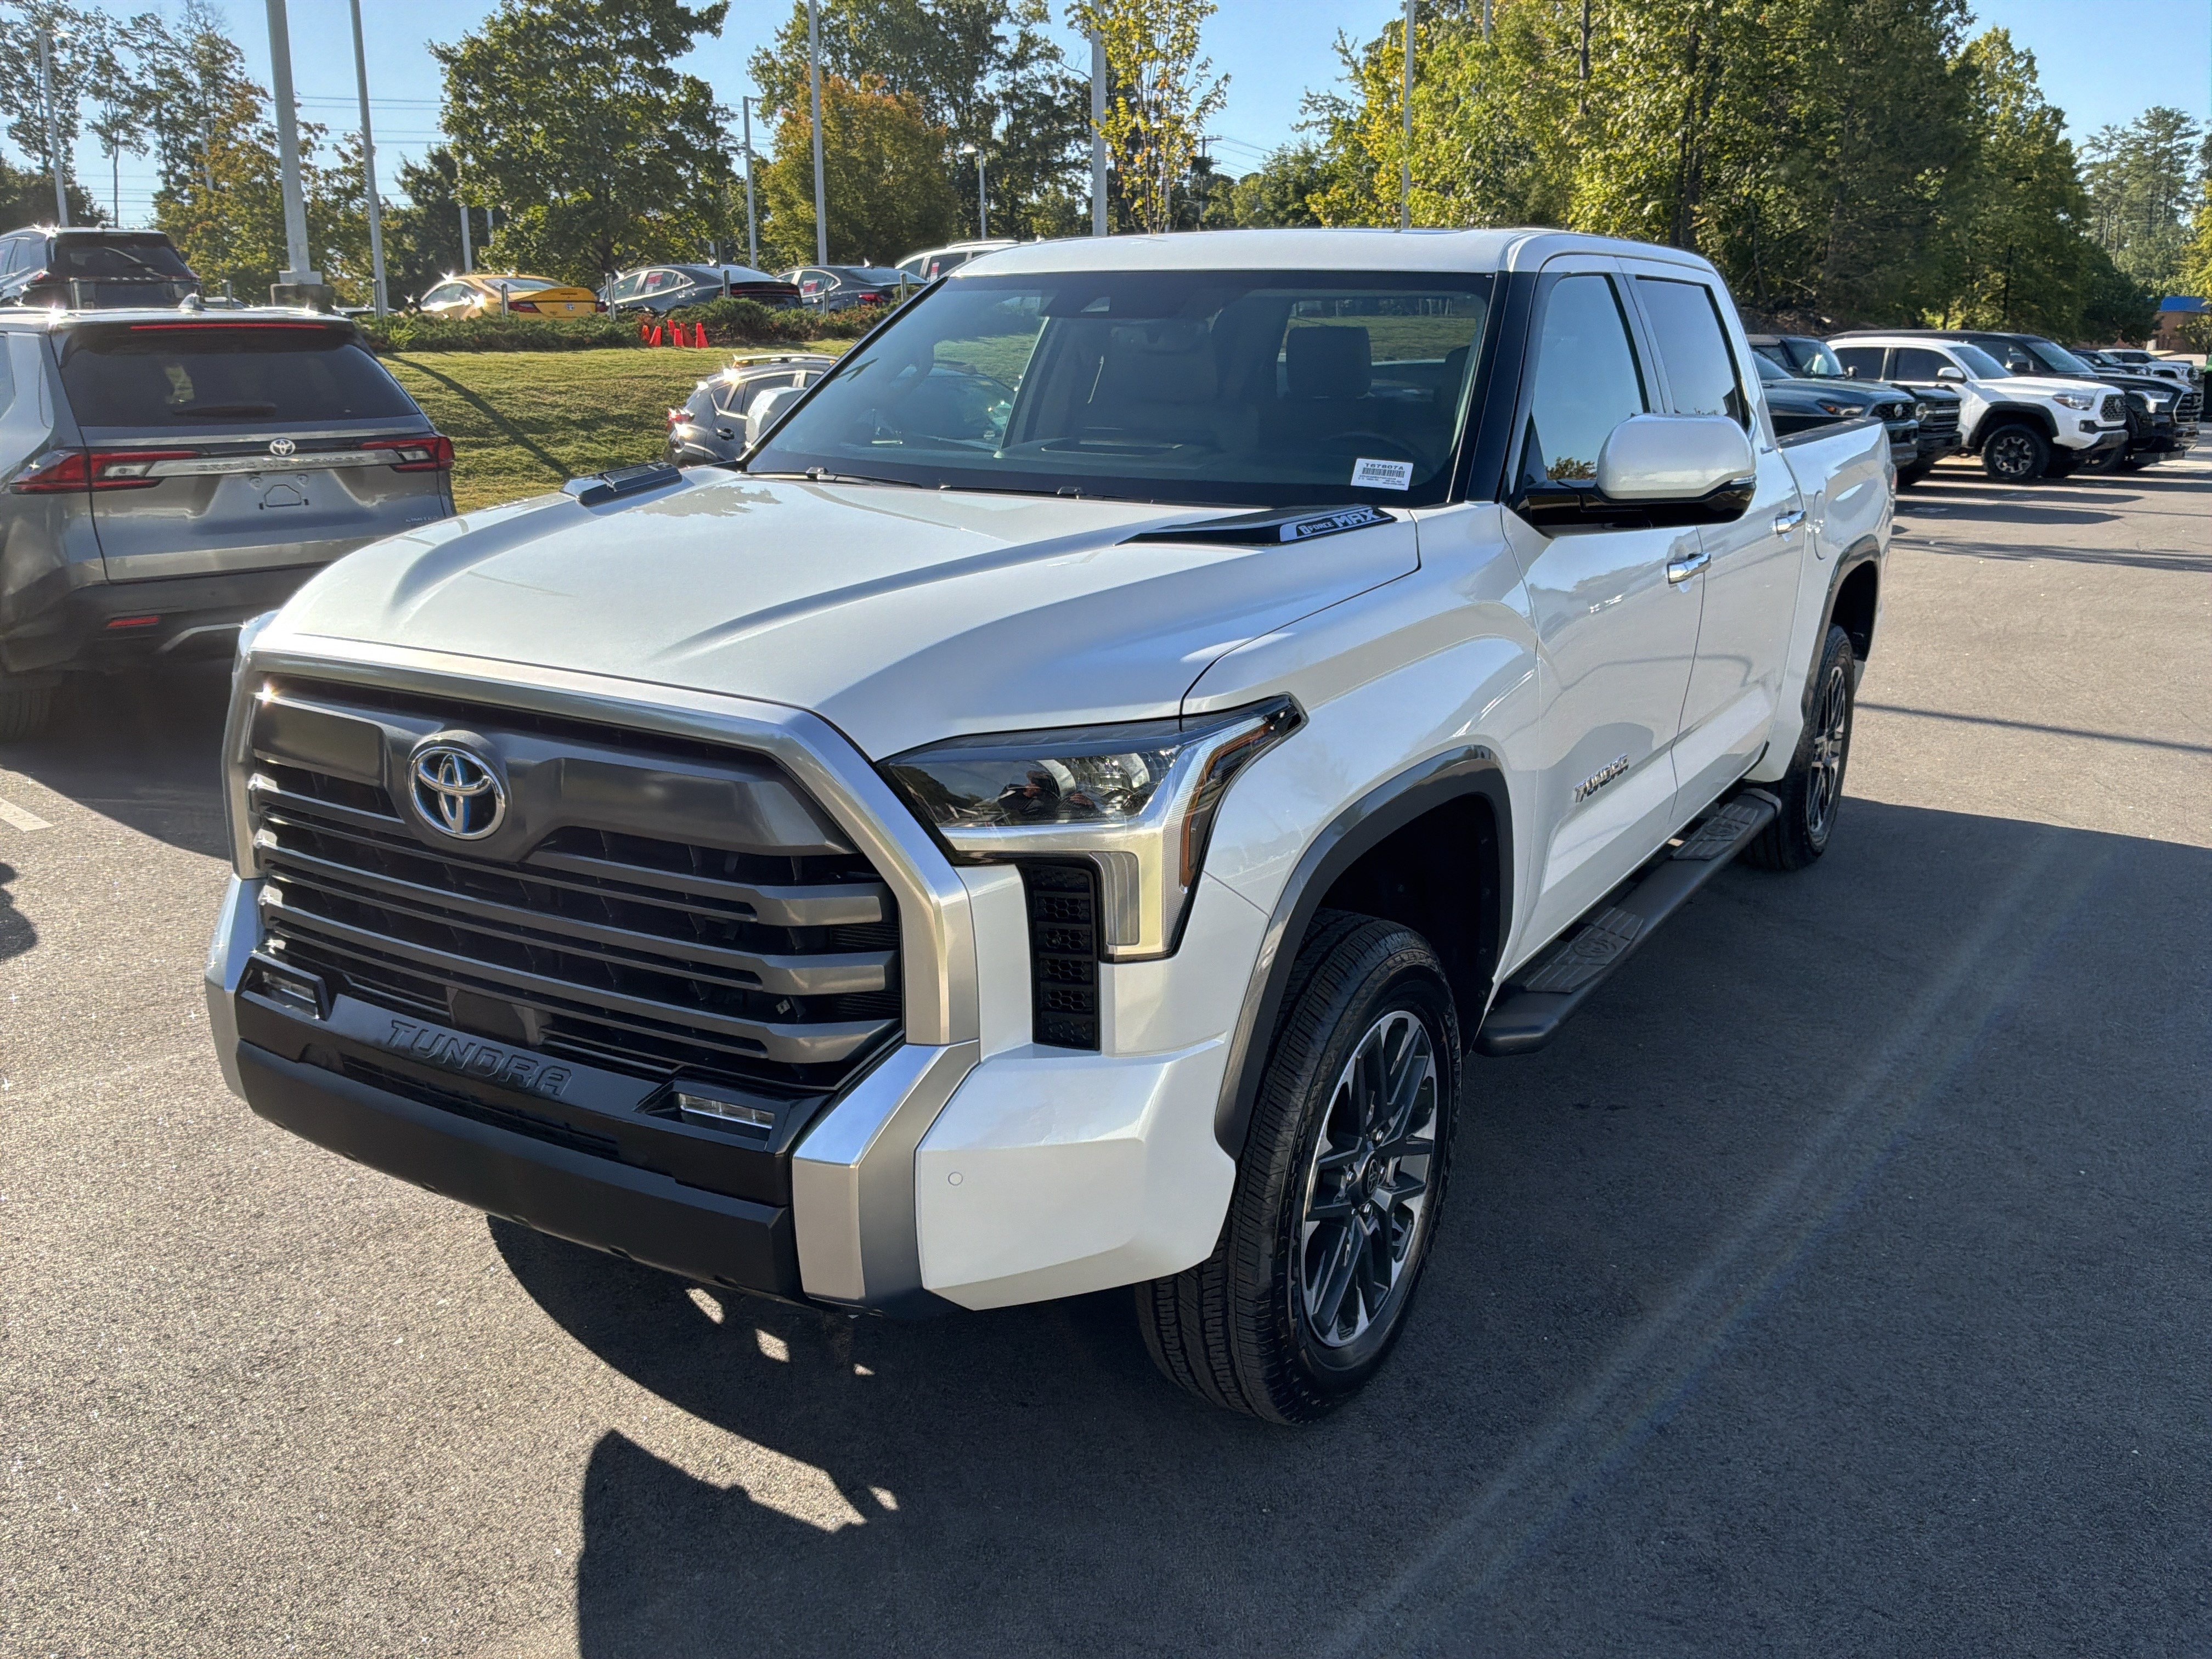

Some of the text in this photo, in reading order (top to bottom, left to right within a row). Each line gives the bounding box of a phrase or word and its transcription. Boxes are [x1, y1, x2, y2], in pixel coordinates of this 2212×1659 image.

[1331, 509, 1380, 528] MAX
[1575, 753, 1629, 803] TUNDRA
[390, 1019, 573, 1096] TUNDRA
